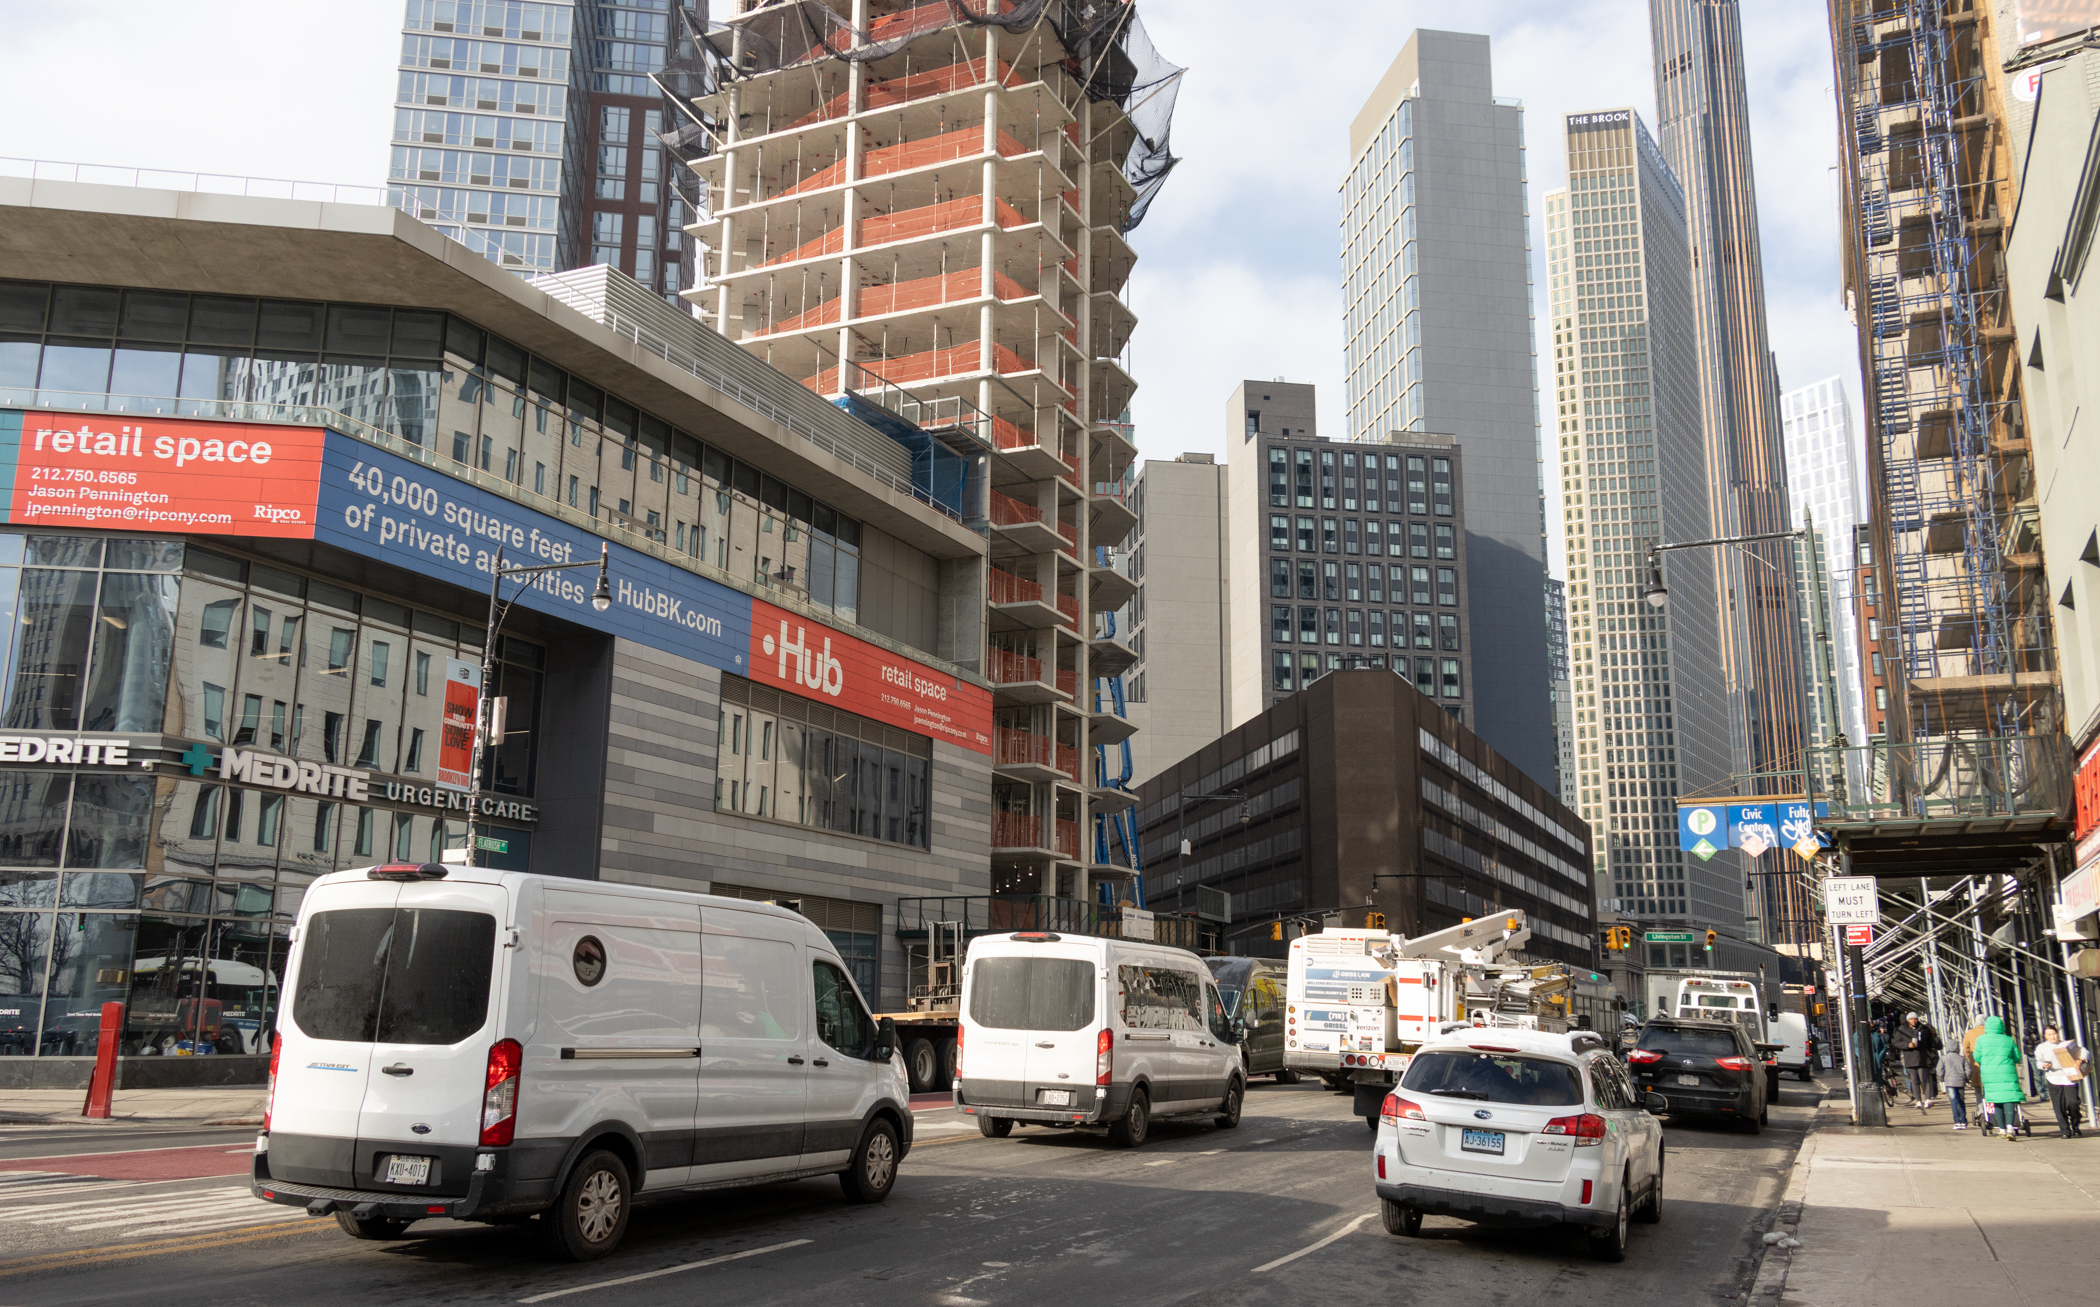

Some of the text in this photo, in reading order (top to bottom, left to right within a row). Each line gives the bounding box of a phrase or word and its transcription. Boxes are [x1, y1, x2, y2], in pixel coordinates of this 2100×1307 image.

[1569, 112, 1629, 126] THE BROOK
[34, 426, 272, 467] retail space
[31, 467, 138, 485] 212.750.6565
[28, 484, 168, 505] Jason Pennington
[24, 501, 232, 525] jpennington@ripcony.com
[254, 504, 300, 523] Ripco
[348, 460, 572, 564] 40,000 square feet
[344, 504, 376, 528] of
[380, 515, 469, 564] private
[618, 578, 721, 638] HubBK.com
[778, 620, 843, 696] Hub
[882, 666, 946, 701] retail space
[446, 702, 474, 719] SHOW
[452, 713, 466, 722] YOUR
[914, 705, 927, 716] Jason
[444, 717, 475, 730] COMMUNITY
[444, 724, 470, 740] SOME
[445, 735, 468, 750] LOVE
[220, 746, 370, 801] MEDRITE
[386, 782, 533, 822] URGENT CARE
[1742, 808, 1762, 820] Civic
[1838, 896, 1863, 905] MUST
[1328, 1011, 1345, 1021] (718)
